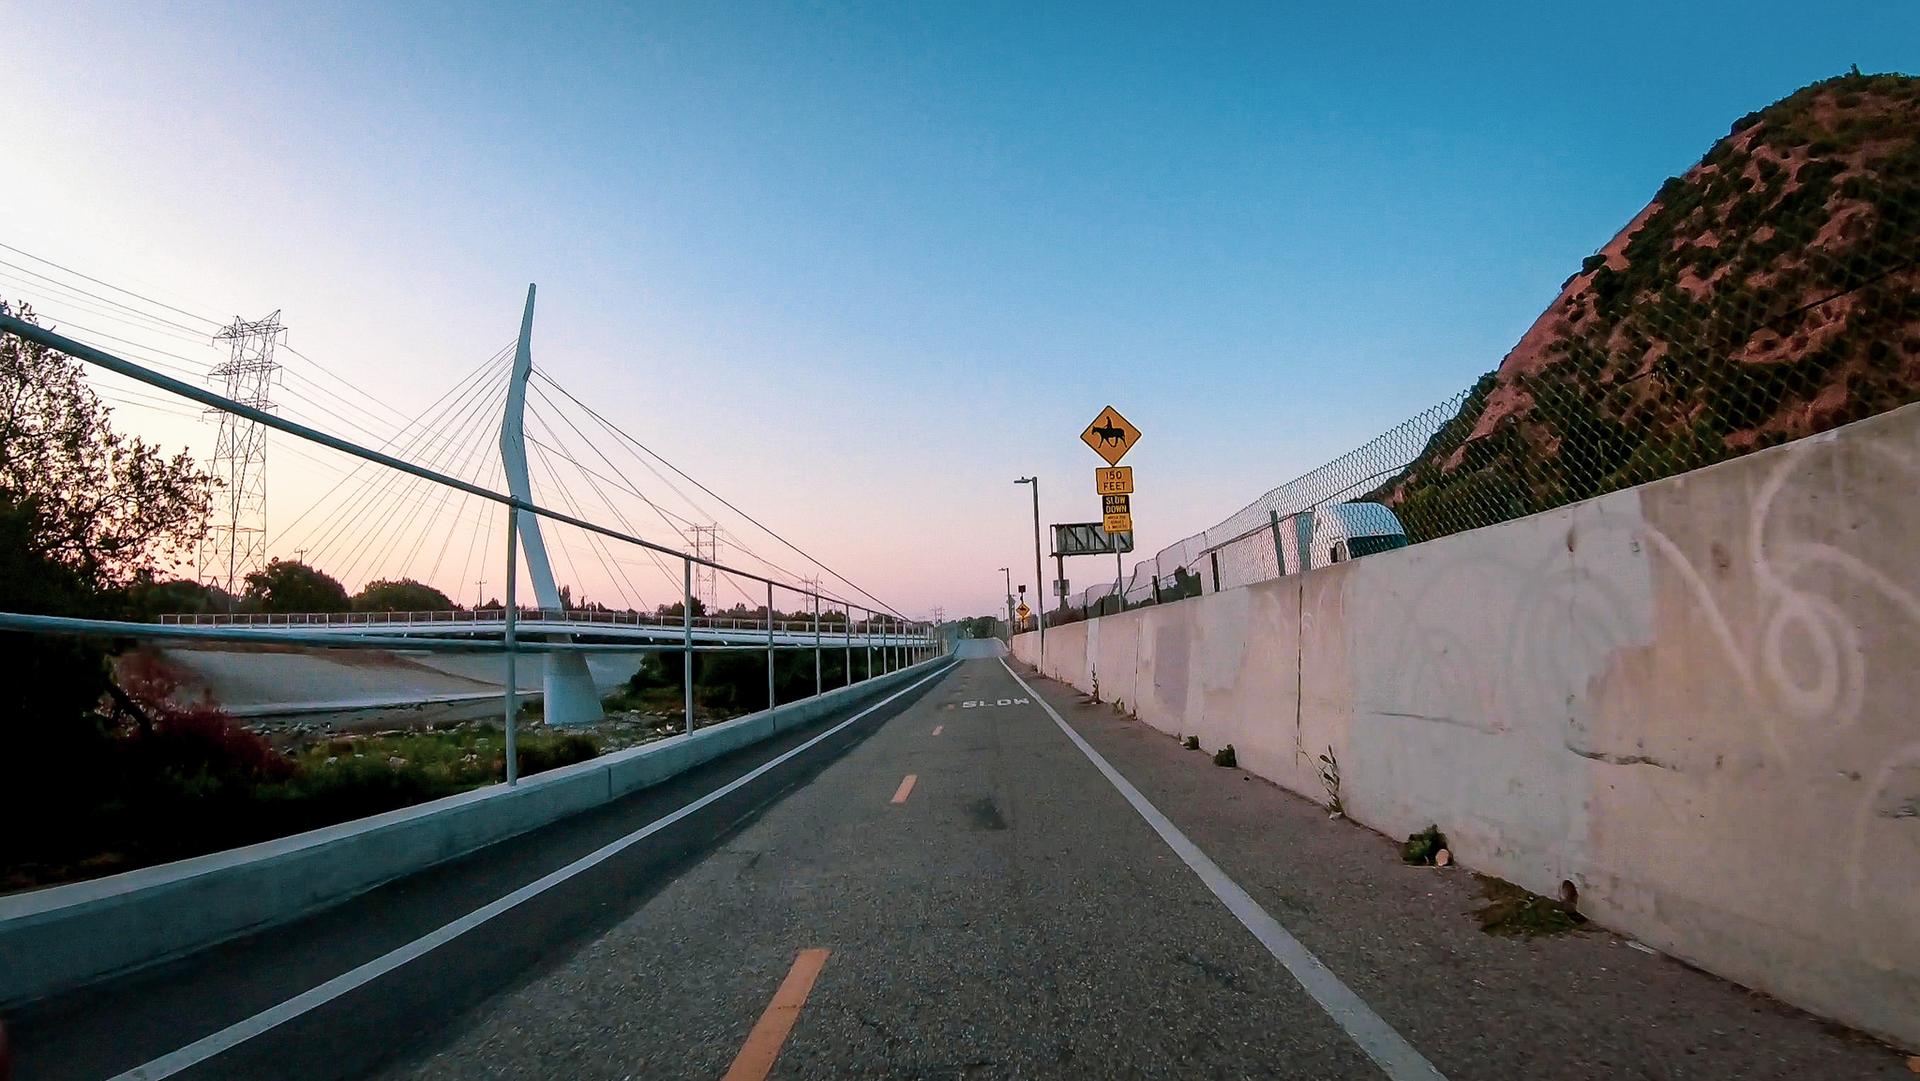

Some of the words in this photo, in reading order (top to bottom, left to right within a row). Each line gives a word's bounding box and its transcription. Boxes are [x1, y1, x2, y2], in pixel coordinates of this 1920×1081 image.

[1105, 471, 1122, 480] 150
[1103, 482, 1125, 491] FEET
[1106, 496, 1125, 504] SLOW
[1106, 505, 1127, 514] DOWN
[962, 698, 1029, 708] SLOW
